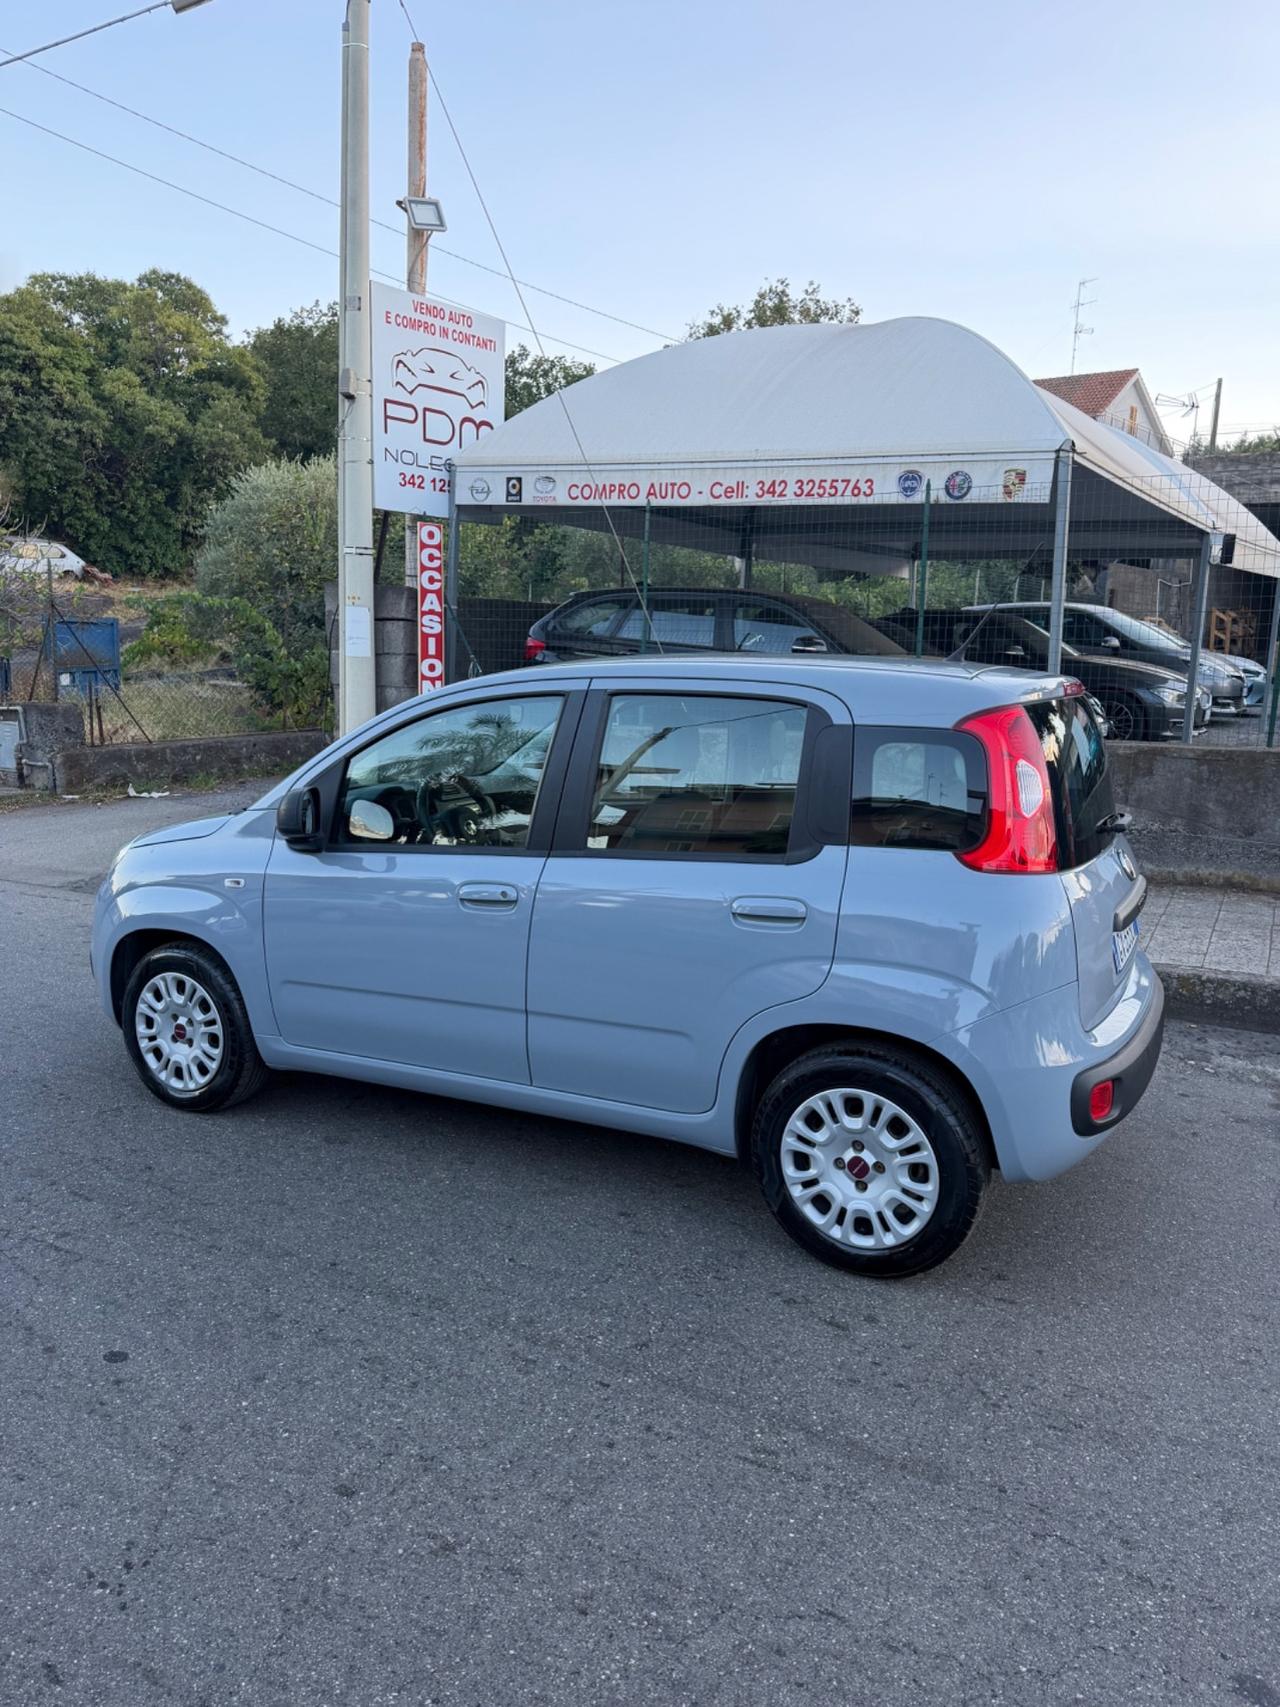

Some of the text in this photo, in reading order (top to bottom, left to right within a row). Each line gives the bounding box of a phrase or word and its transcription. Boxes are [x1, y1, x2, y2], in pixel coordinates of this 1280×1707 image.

[412, 299, 473, 328] VENDO AUTO
[385, 311, 496, 352] E COMPRO IN CONTANTI
[398, 472, 425, 489] 342
[567, 483, 641, 500] COMPRO
[645, 482, 691, 499] AUTO
[709, 481, 749, 499] Cell:
[755, 479, 788, 498] 342
[793, 478, 874, 497] 3255763
